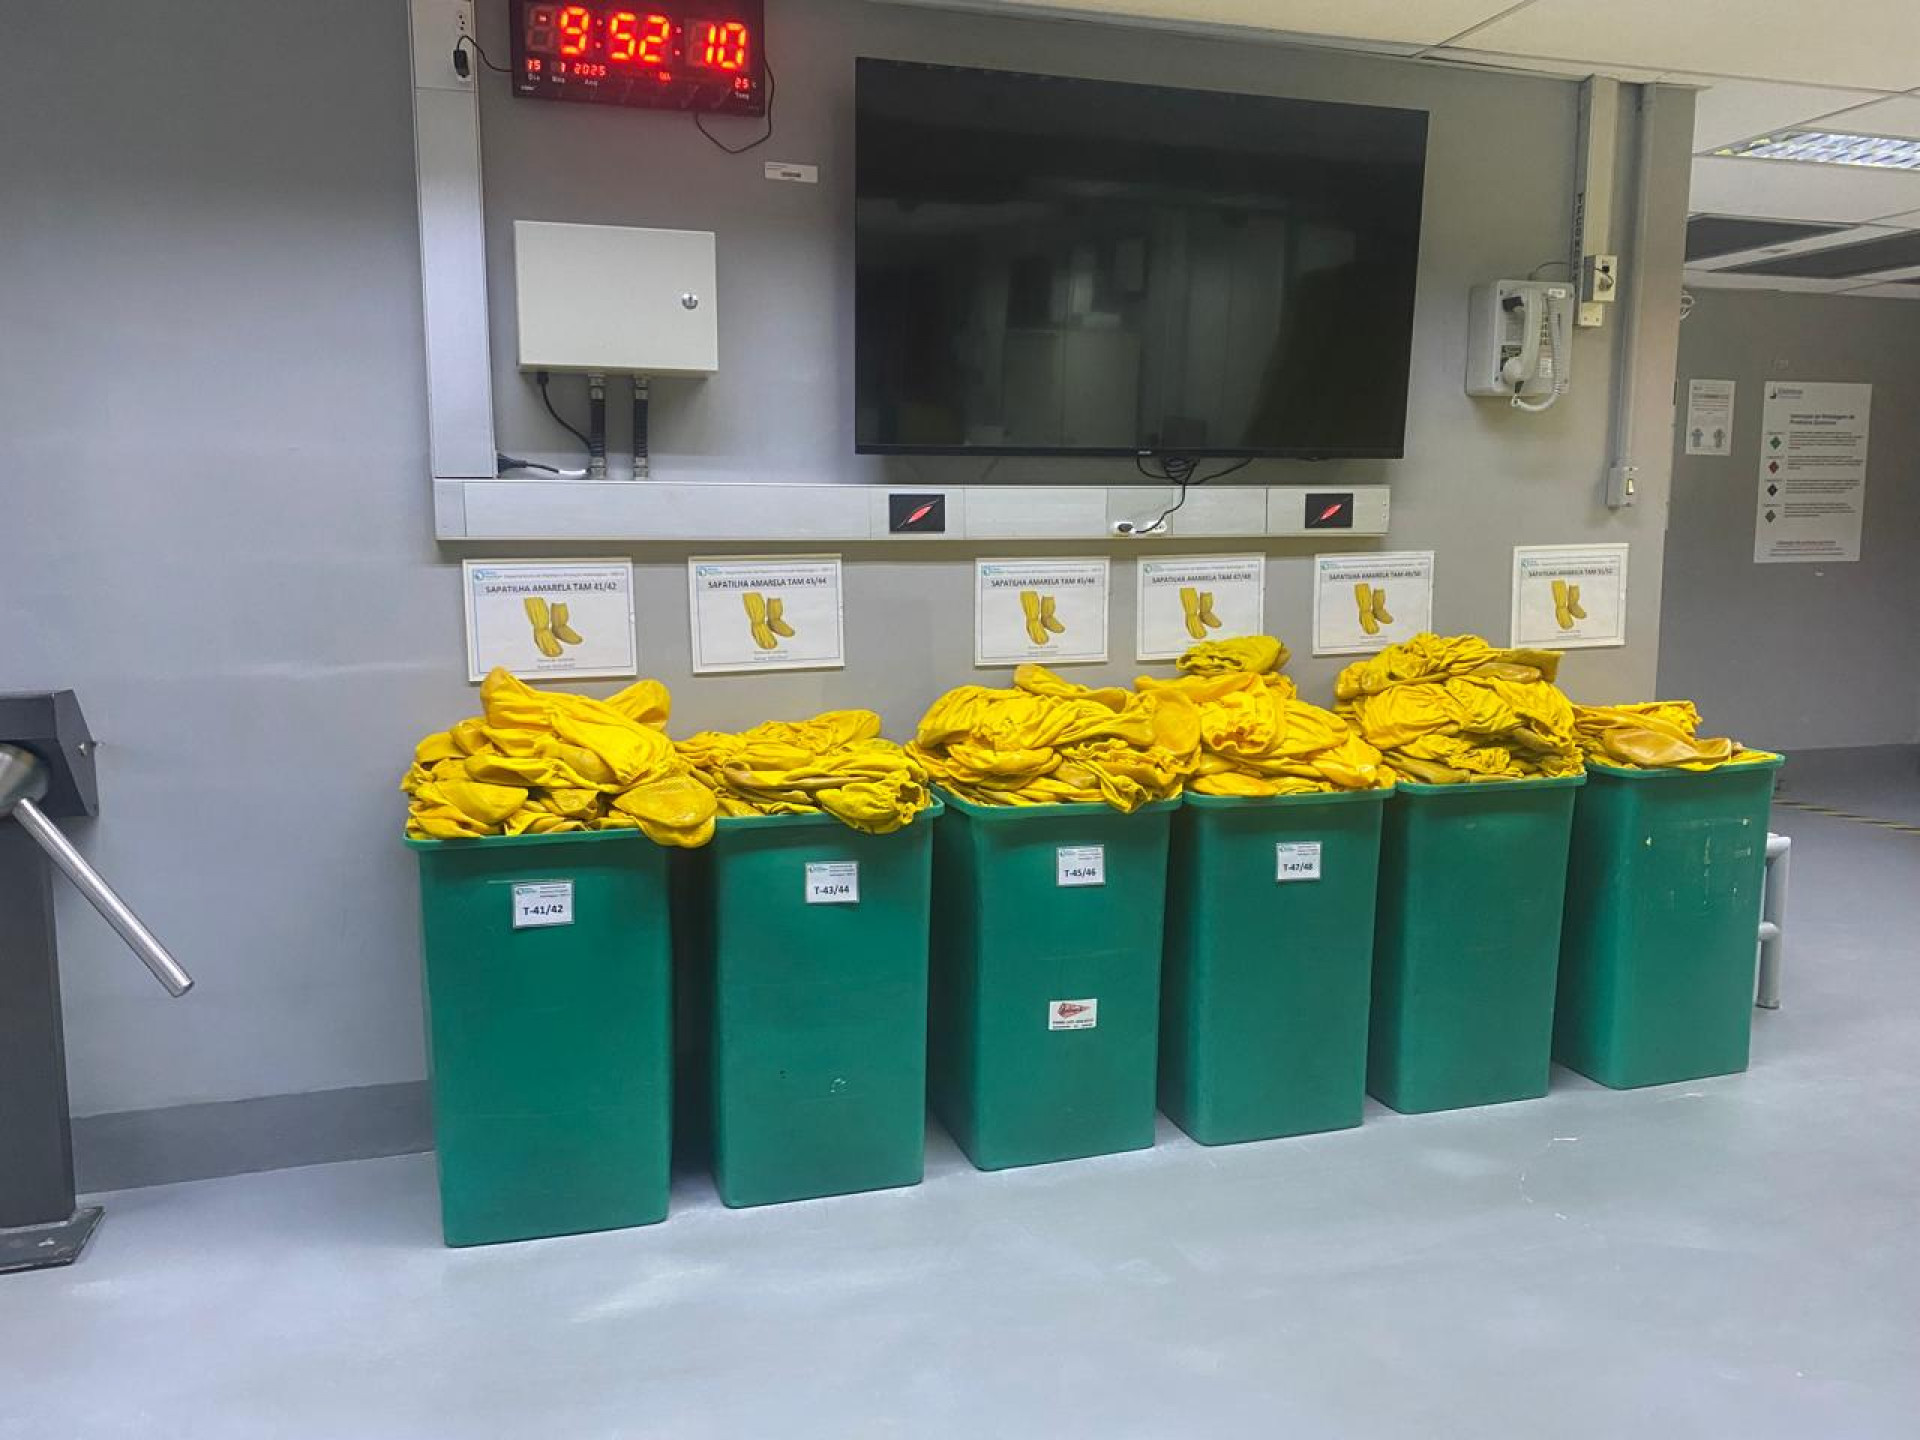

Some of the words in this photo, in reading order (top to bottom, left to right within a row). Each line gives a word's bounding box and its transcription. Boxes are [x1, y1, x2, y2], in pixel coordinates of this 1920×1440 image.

[527, 59, 541, 71] 15
[574, 62, 606, 76] 2025
[734, 77, 749, 89] 25
[707, 579, 749, 589] SAPATILHA
[750, 577, 787, 587] AMARELA
[787, 577, 805, 586] TAM
[990, 578, 1027, 587] SAPATILHA
[1027, 577, 1060, 586] AMARELA
[1060, 577, 1076, 585] TAM
[1151, 576, 1186, 584] SAPATILHA
[1187, 574, 1217, 582] AMARELA
[1217, 573, 1232, 581] TAM
[485, 584, 530, 593] SAPATILHA
[532, 583, 572, 592] AMARELA
[572, 582, 592, 591] TAM
[593, 582, 617, 592] 41/42
[522, 903, 564, 916] T-41/42
